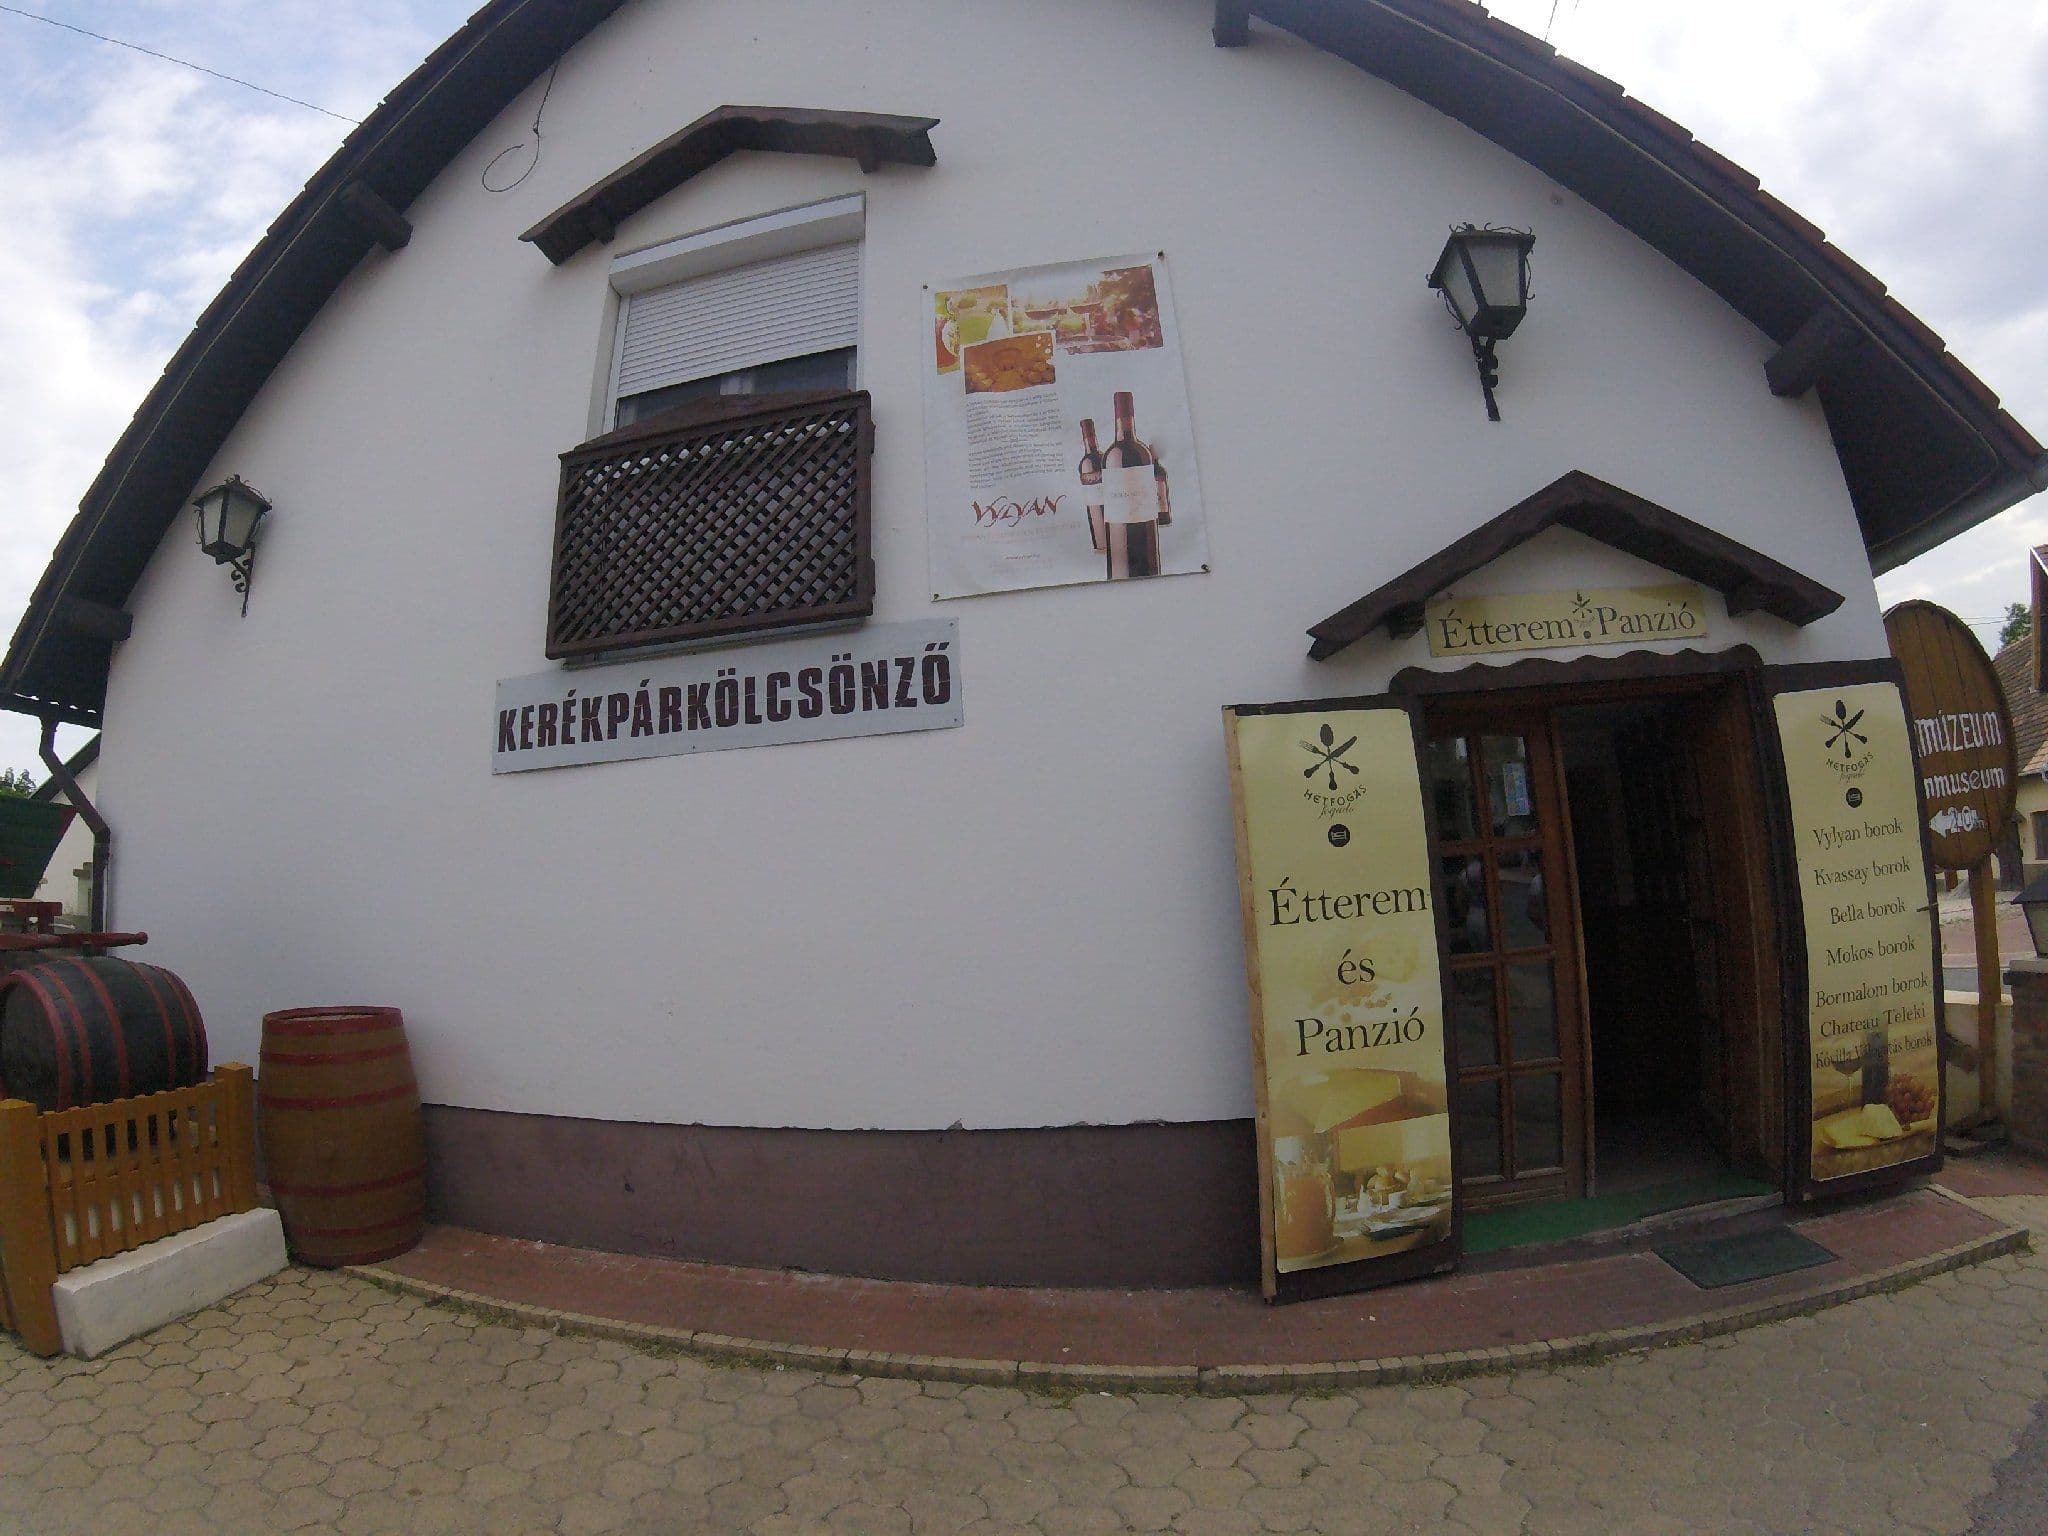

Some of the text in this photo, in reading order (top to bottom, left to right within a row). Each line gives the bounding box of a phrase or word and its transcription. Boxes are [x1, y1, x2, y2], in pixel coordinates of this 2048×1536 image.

[1438, 608, 1577, 649] Étterem
[1594, 602, 1696, 636] Panzió
[497, 641, 952, 753] KERÉKPÁRKÖLCSÖNZŐ
[1813, 817, 1904, 850] Vylyan borok
[1814, 856, 1911, 886] Kvassay borok
[1268, 876, 1429, 926] Étterem
[1830, 897, 1907, 925] Bella borok
[1336, 949, 1376, 985] és
[1826, 934, 1917, 967] Mokos borok
[1815, 971, 1929, 1008] Bormalom borok
[1294, 1006, 1425, 1057] Panzió
[1883, 1002, 1927, 1025] Teleki
